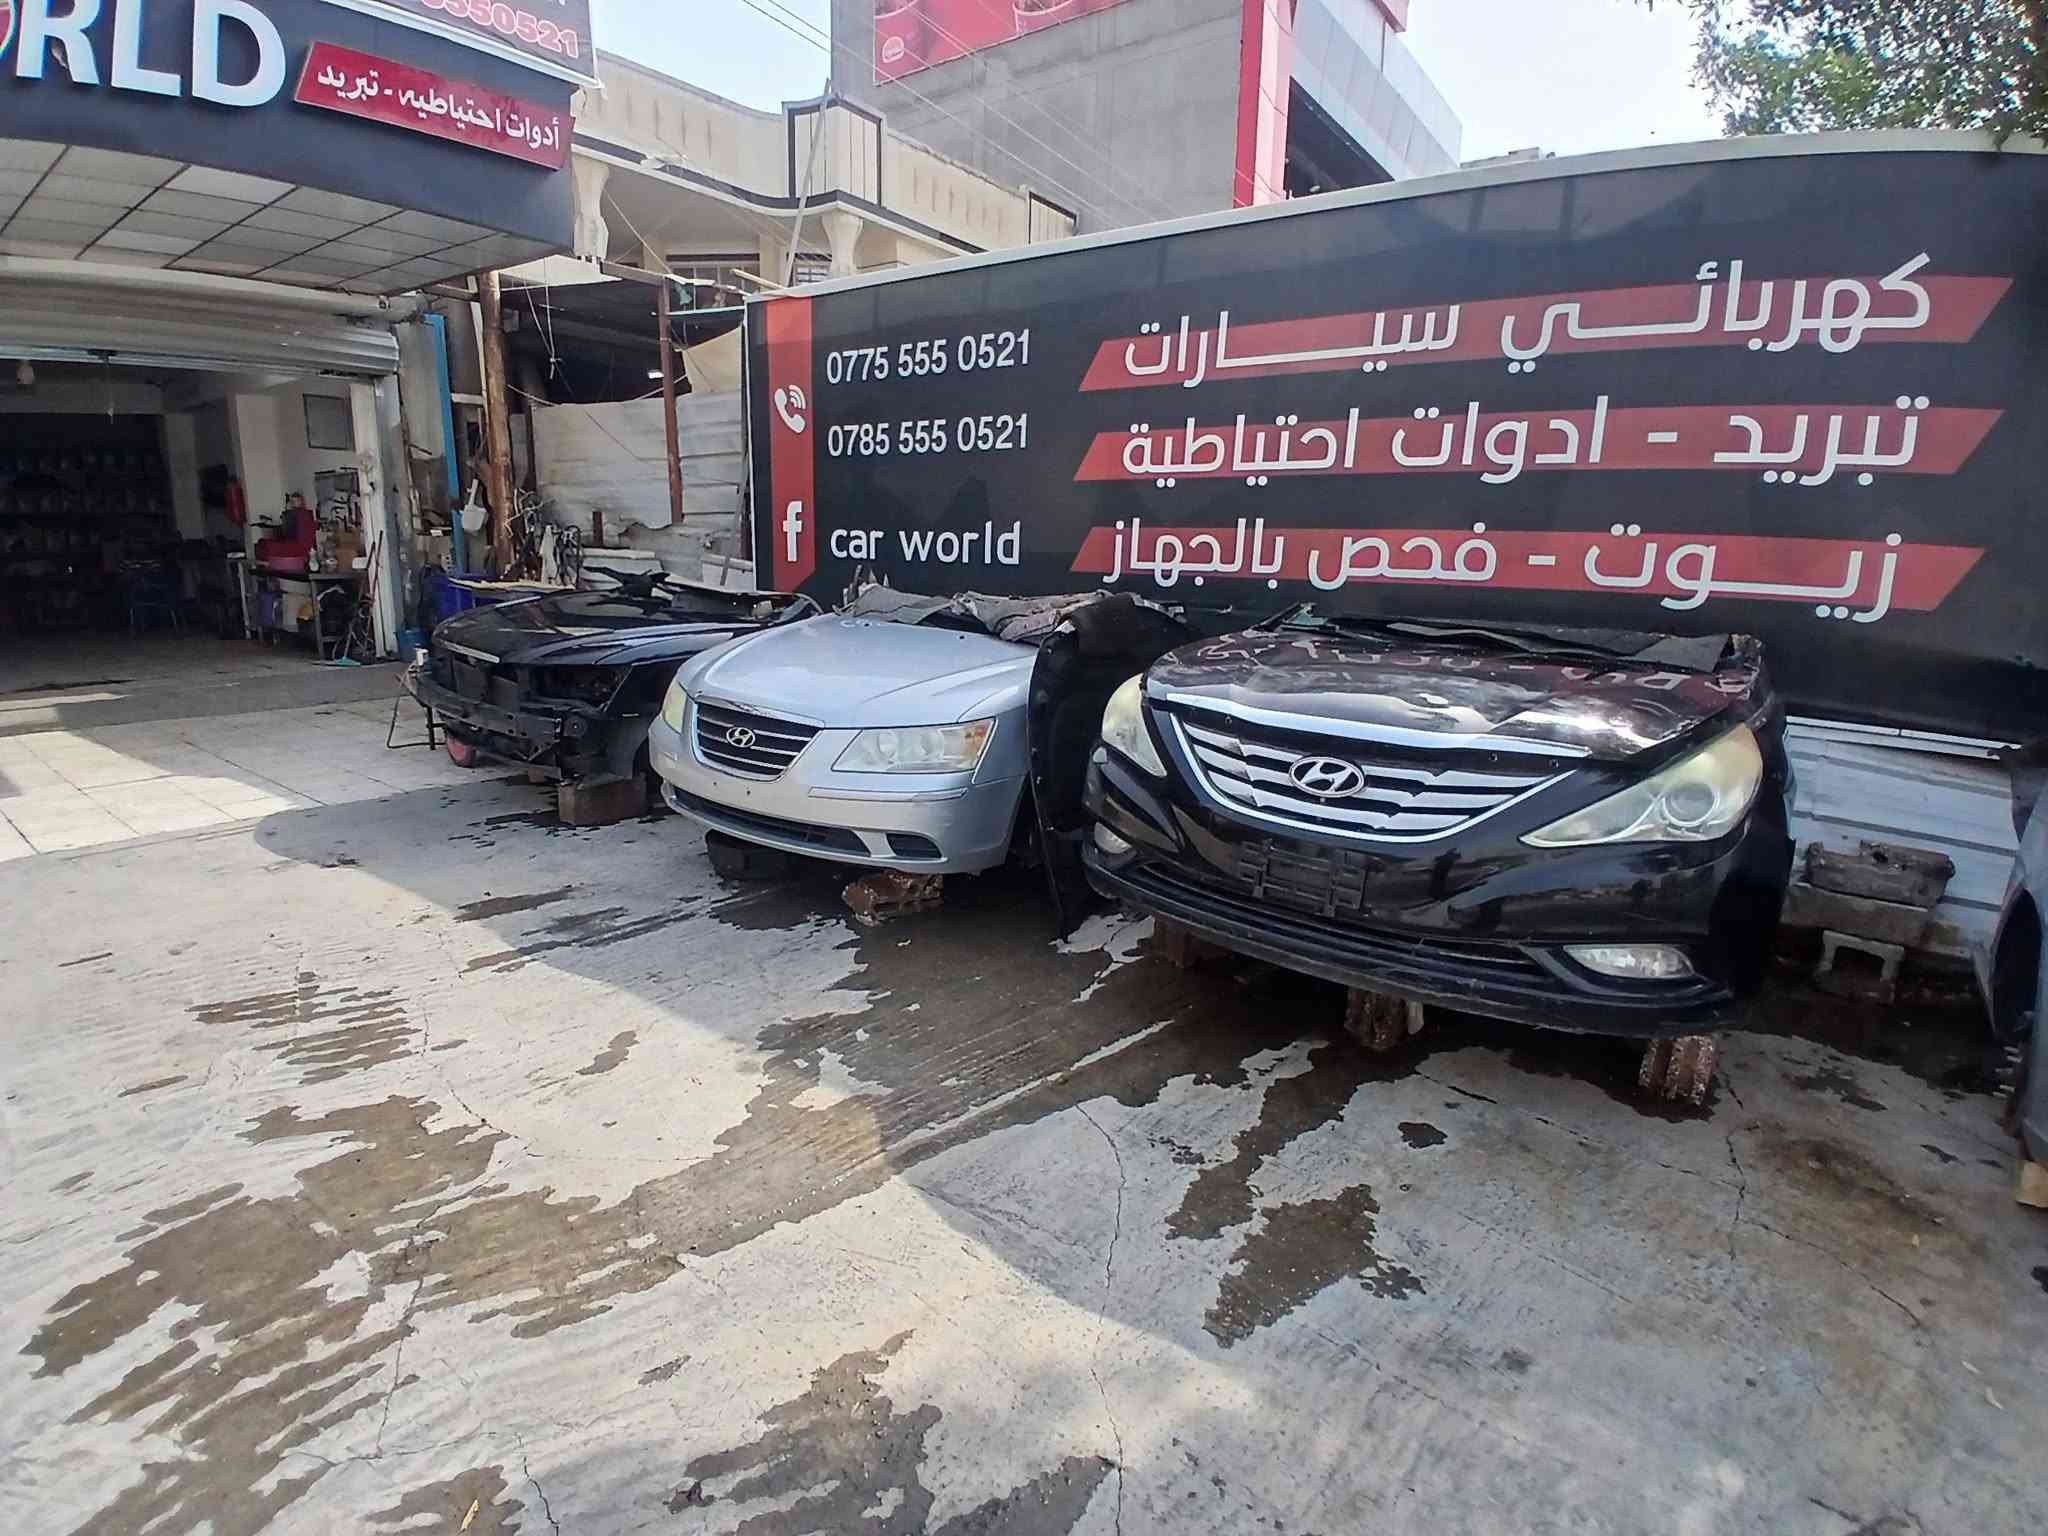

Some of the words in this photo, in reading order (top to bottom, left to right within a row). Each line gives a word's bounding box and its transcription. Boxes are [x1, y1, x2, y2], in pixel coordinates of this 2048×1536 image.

[317, 65, 380, 101] تبريد
[505, 111, 560, 150] أدوات
[826, 346, 890, 384] 0775
[897, 338, 948, 377] 555
[957, 328, 1030, 372] 0521
[827, 422, 890, 457] 0785
[897, 418, 948, 455] 555
[956, 412, 1028, 452] 0521
[1121, 406, 1361, 489] احتياطية
[1390, 395, 1610, 485] ادوات
[1712, 394, 1931, 487] تبريد
[829, 528, 884, 560] car
[898, 519, 1021, 565] world
[1102, 517, 1286, 588] بالجهاز
[1307, 521, 1498, 591] فحص
